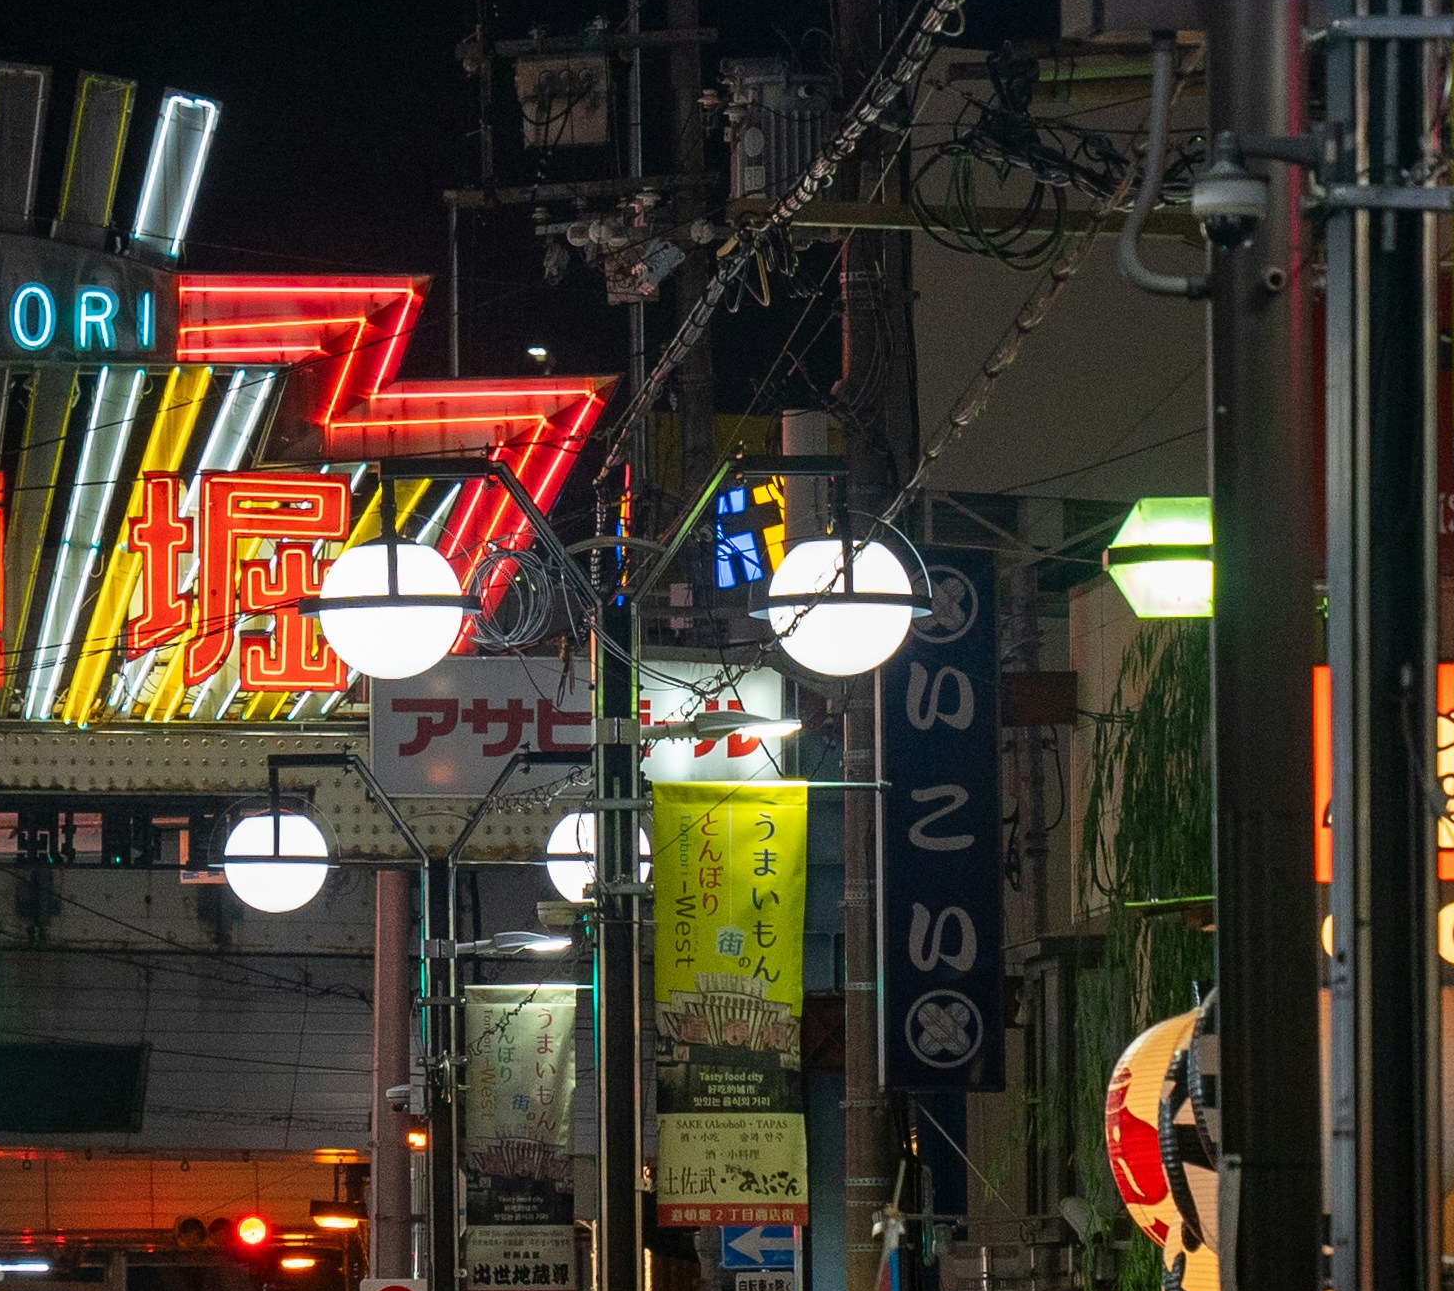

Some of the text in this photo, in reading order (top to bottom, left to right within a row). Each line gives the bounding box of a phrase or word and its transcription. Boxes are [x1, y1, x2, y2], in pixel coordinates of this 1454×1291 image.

[905, 661, 978, 974] いこい
[697, 811, 724, 917] とんぼり
[750, 812, 780, 984] うまいもん
[717, 931, 744, 955] 街
[737, 955, 751, 969] の
[535, 1008, 555, 1132] うまいもん
[698, 1071, 765, 1084] Tasty food city
[675, 1119, 701, 1129] SAKE
[755, 1119, 788, 1129] TAPAS
